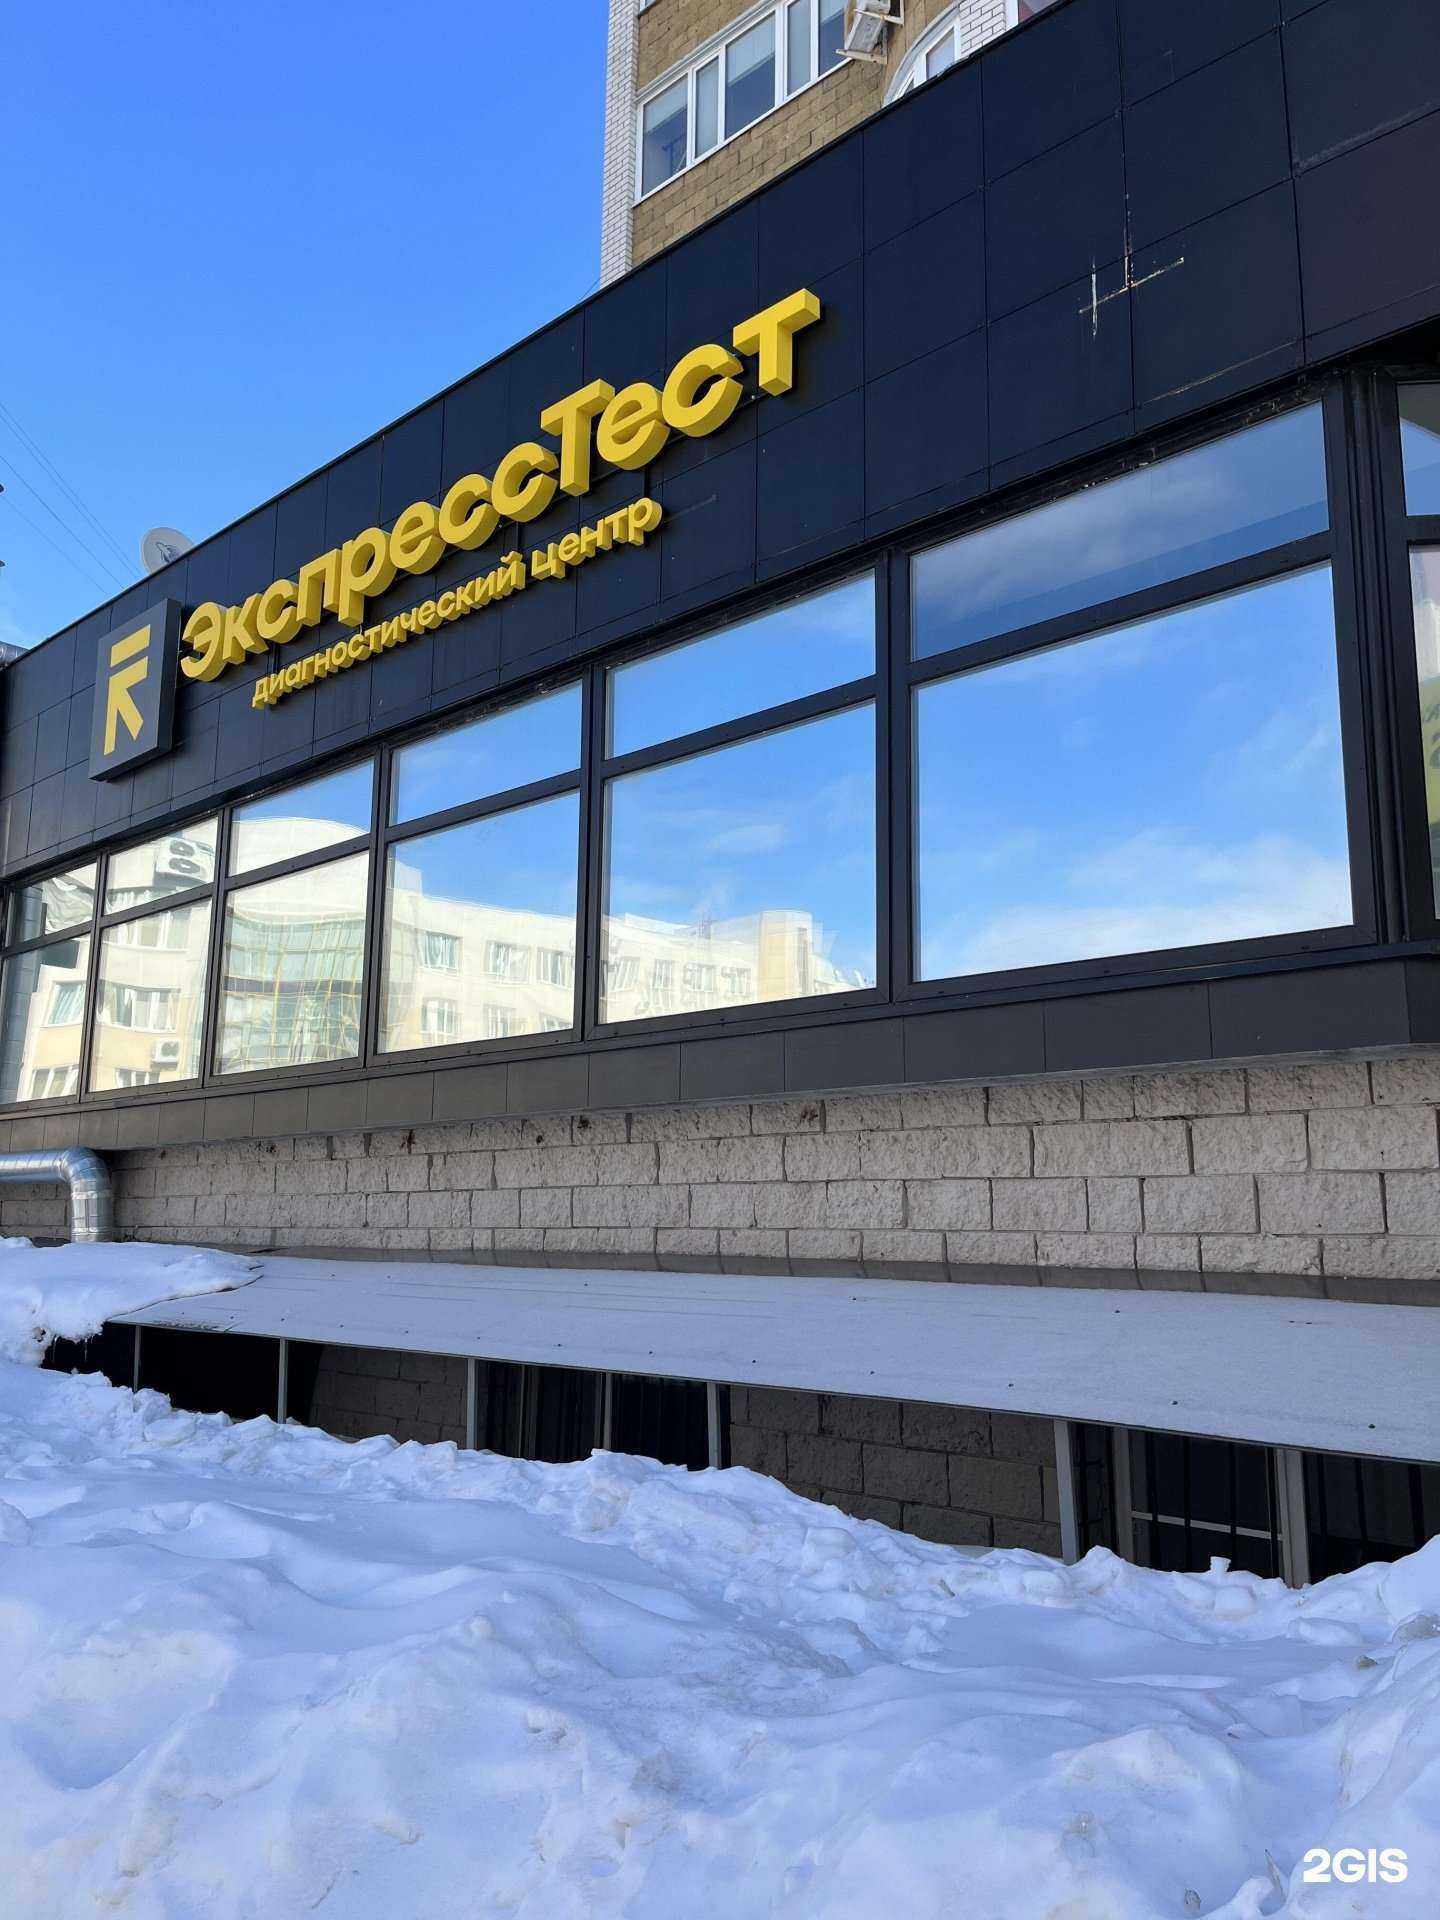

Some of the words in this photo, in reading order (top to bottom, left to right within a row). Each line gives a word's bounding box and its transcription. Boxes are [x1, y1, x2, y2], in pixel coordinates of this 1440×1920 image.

[180, 287, 821, 682] ЭкспрессТест
[251, 550, 526, 710] диагностический
[531, 497, 663, 580] центр
